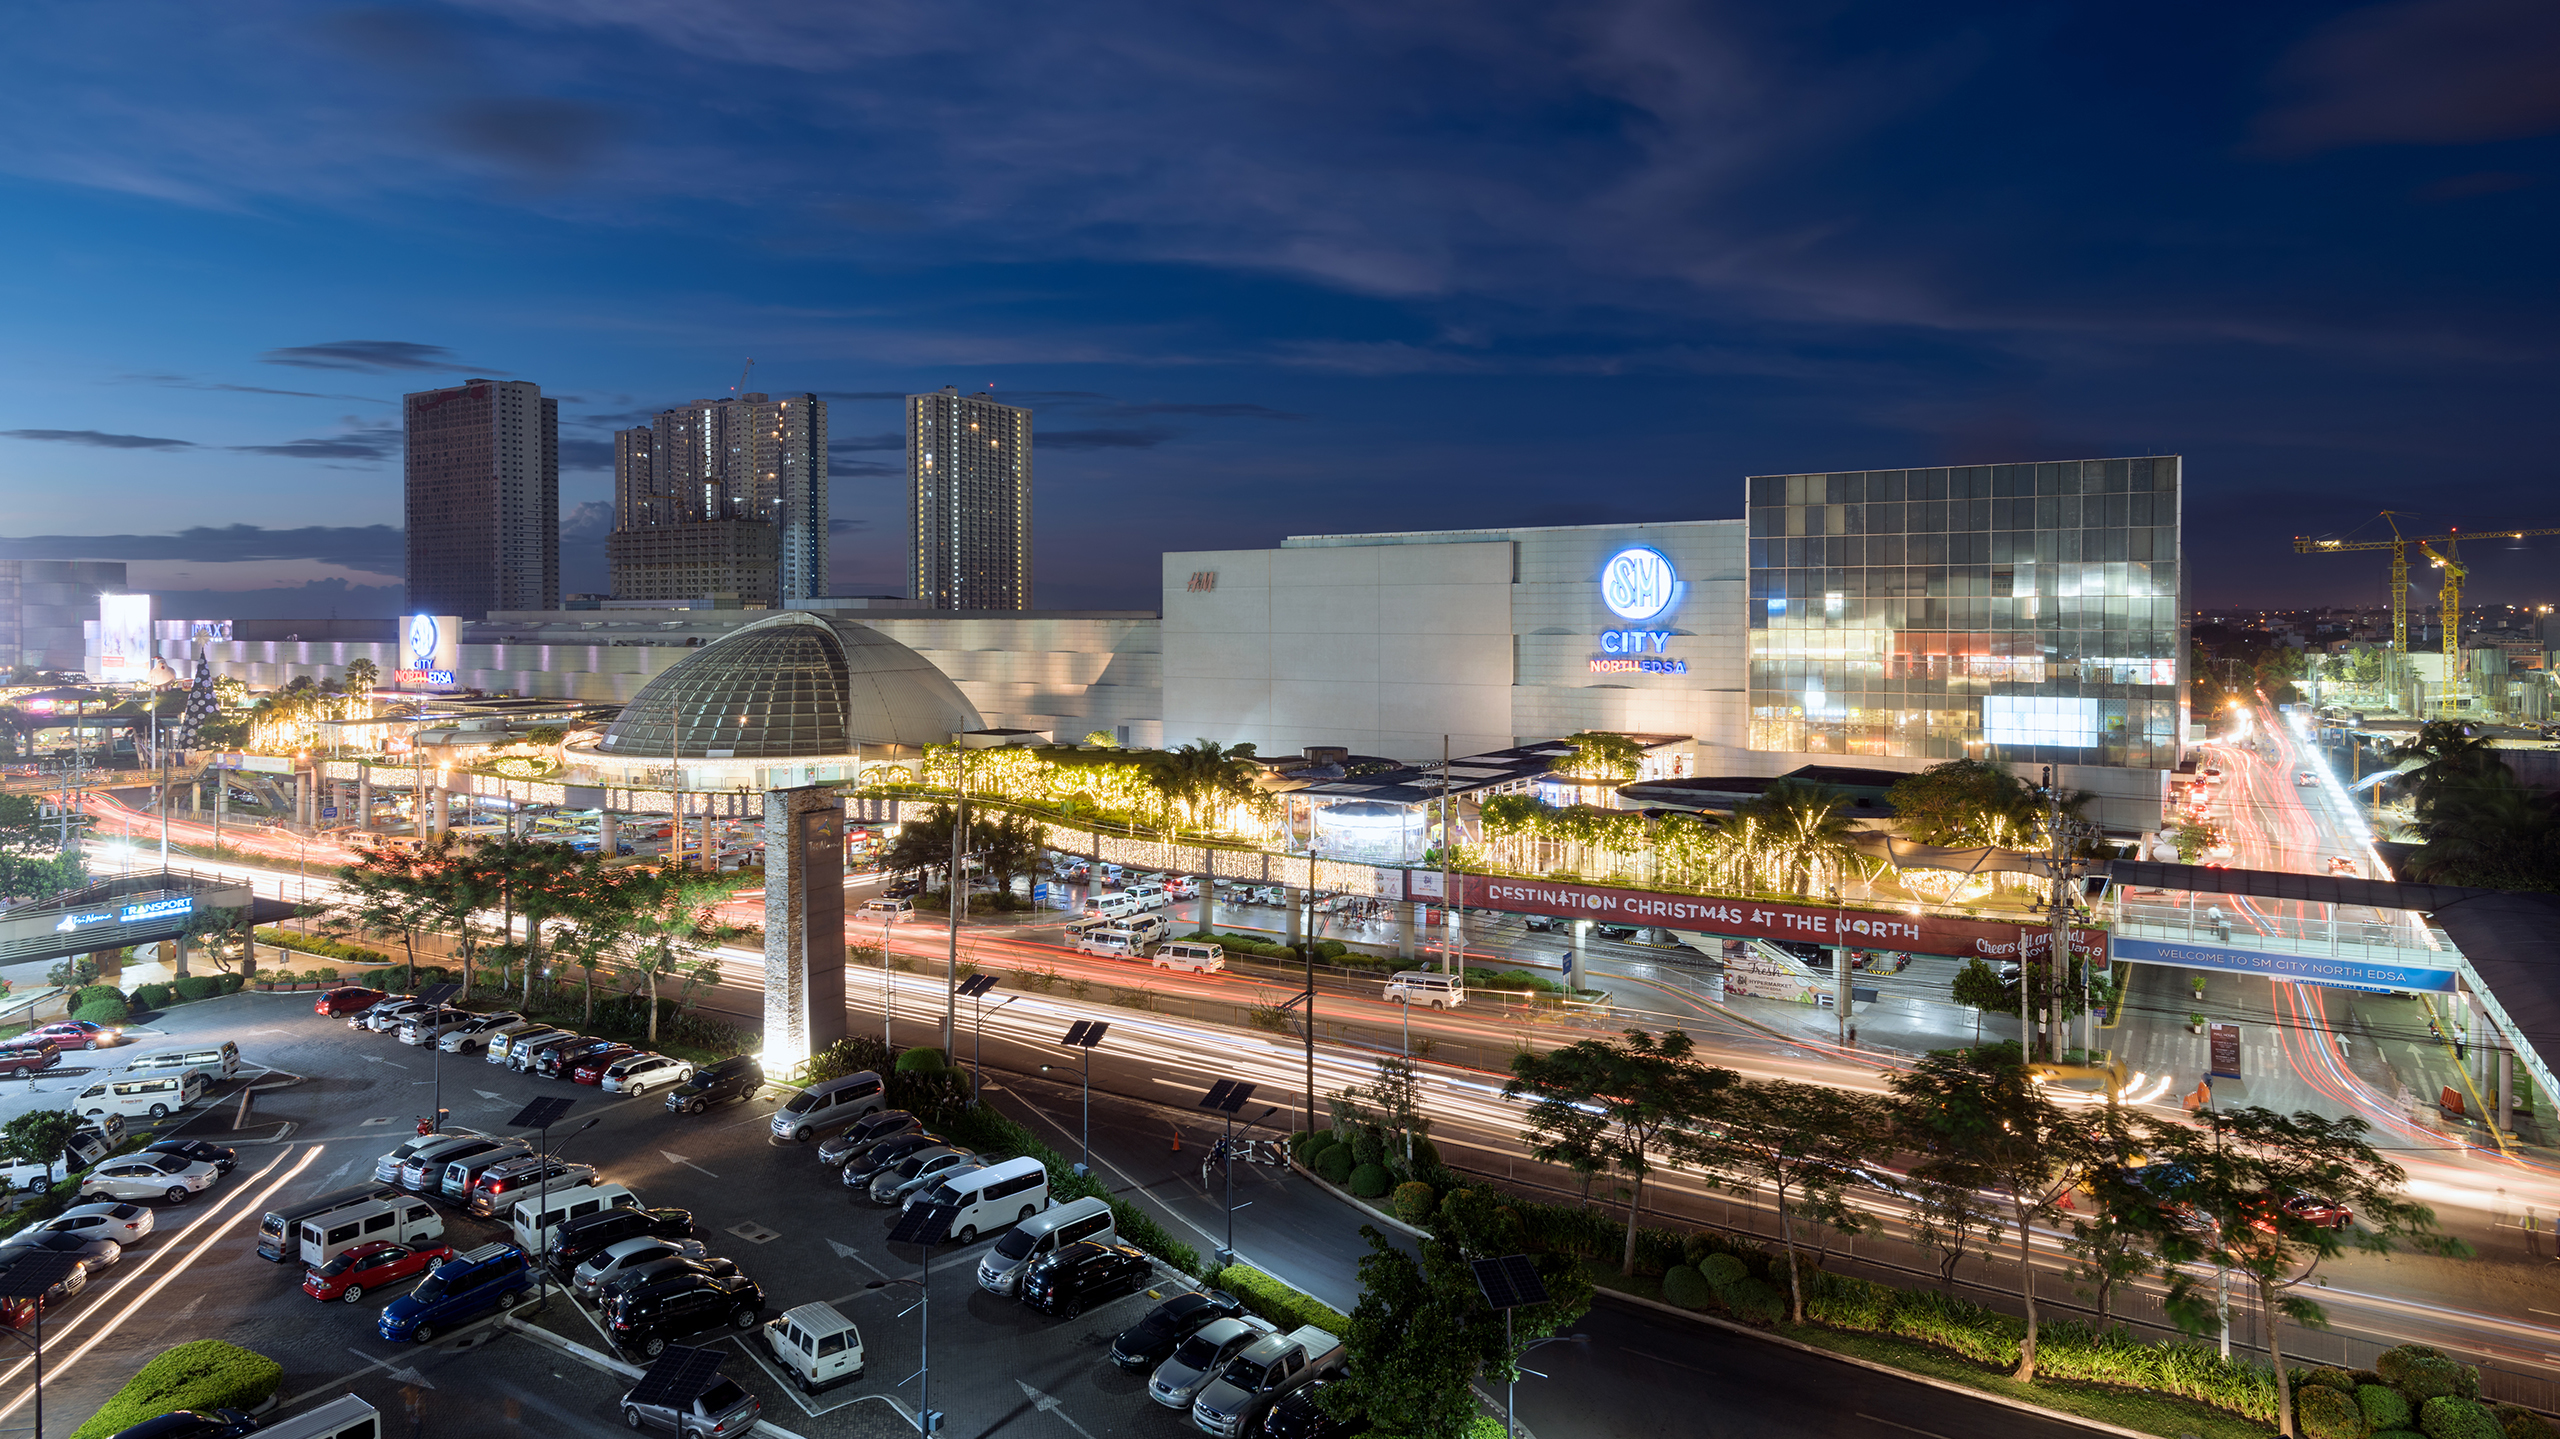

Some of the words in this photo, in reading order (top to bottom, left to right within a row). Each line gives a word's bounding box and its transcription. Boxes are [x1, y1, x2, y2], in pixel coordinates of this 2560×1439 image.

[1609, 556, 1660, 609] SM
[1601, 631, 1670, 654] CITY
[414, 659, 434, 670] CITY
[121, 897, 193, 916] TRANSPORT
[1623, 898, 1743, 925] CHRISTMAS
[1782, 913, 1827, 933] THE
[1835, 918, 1919, 941] NORTH
[1976, 938, 2016, 954] Cheers
[2092, 947, 2103, 957] 8
[1747, 961, 1783, 978] Fresh
[2158, 948, 2225, 963] WELCOME
[2229, 955, 2248, 966] TO
[2252, 957, 2272, 968] SM
[2276, 960, 2308, 971] CITY
[2312, 964, 2363, 977] NORTH
[2367, 970, 2407, 982] EDSA
[1749, 980, 1792, 989] HYPERMARKET
